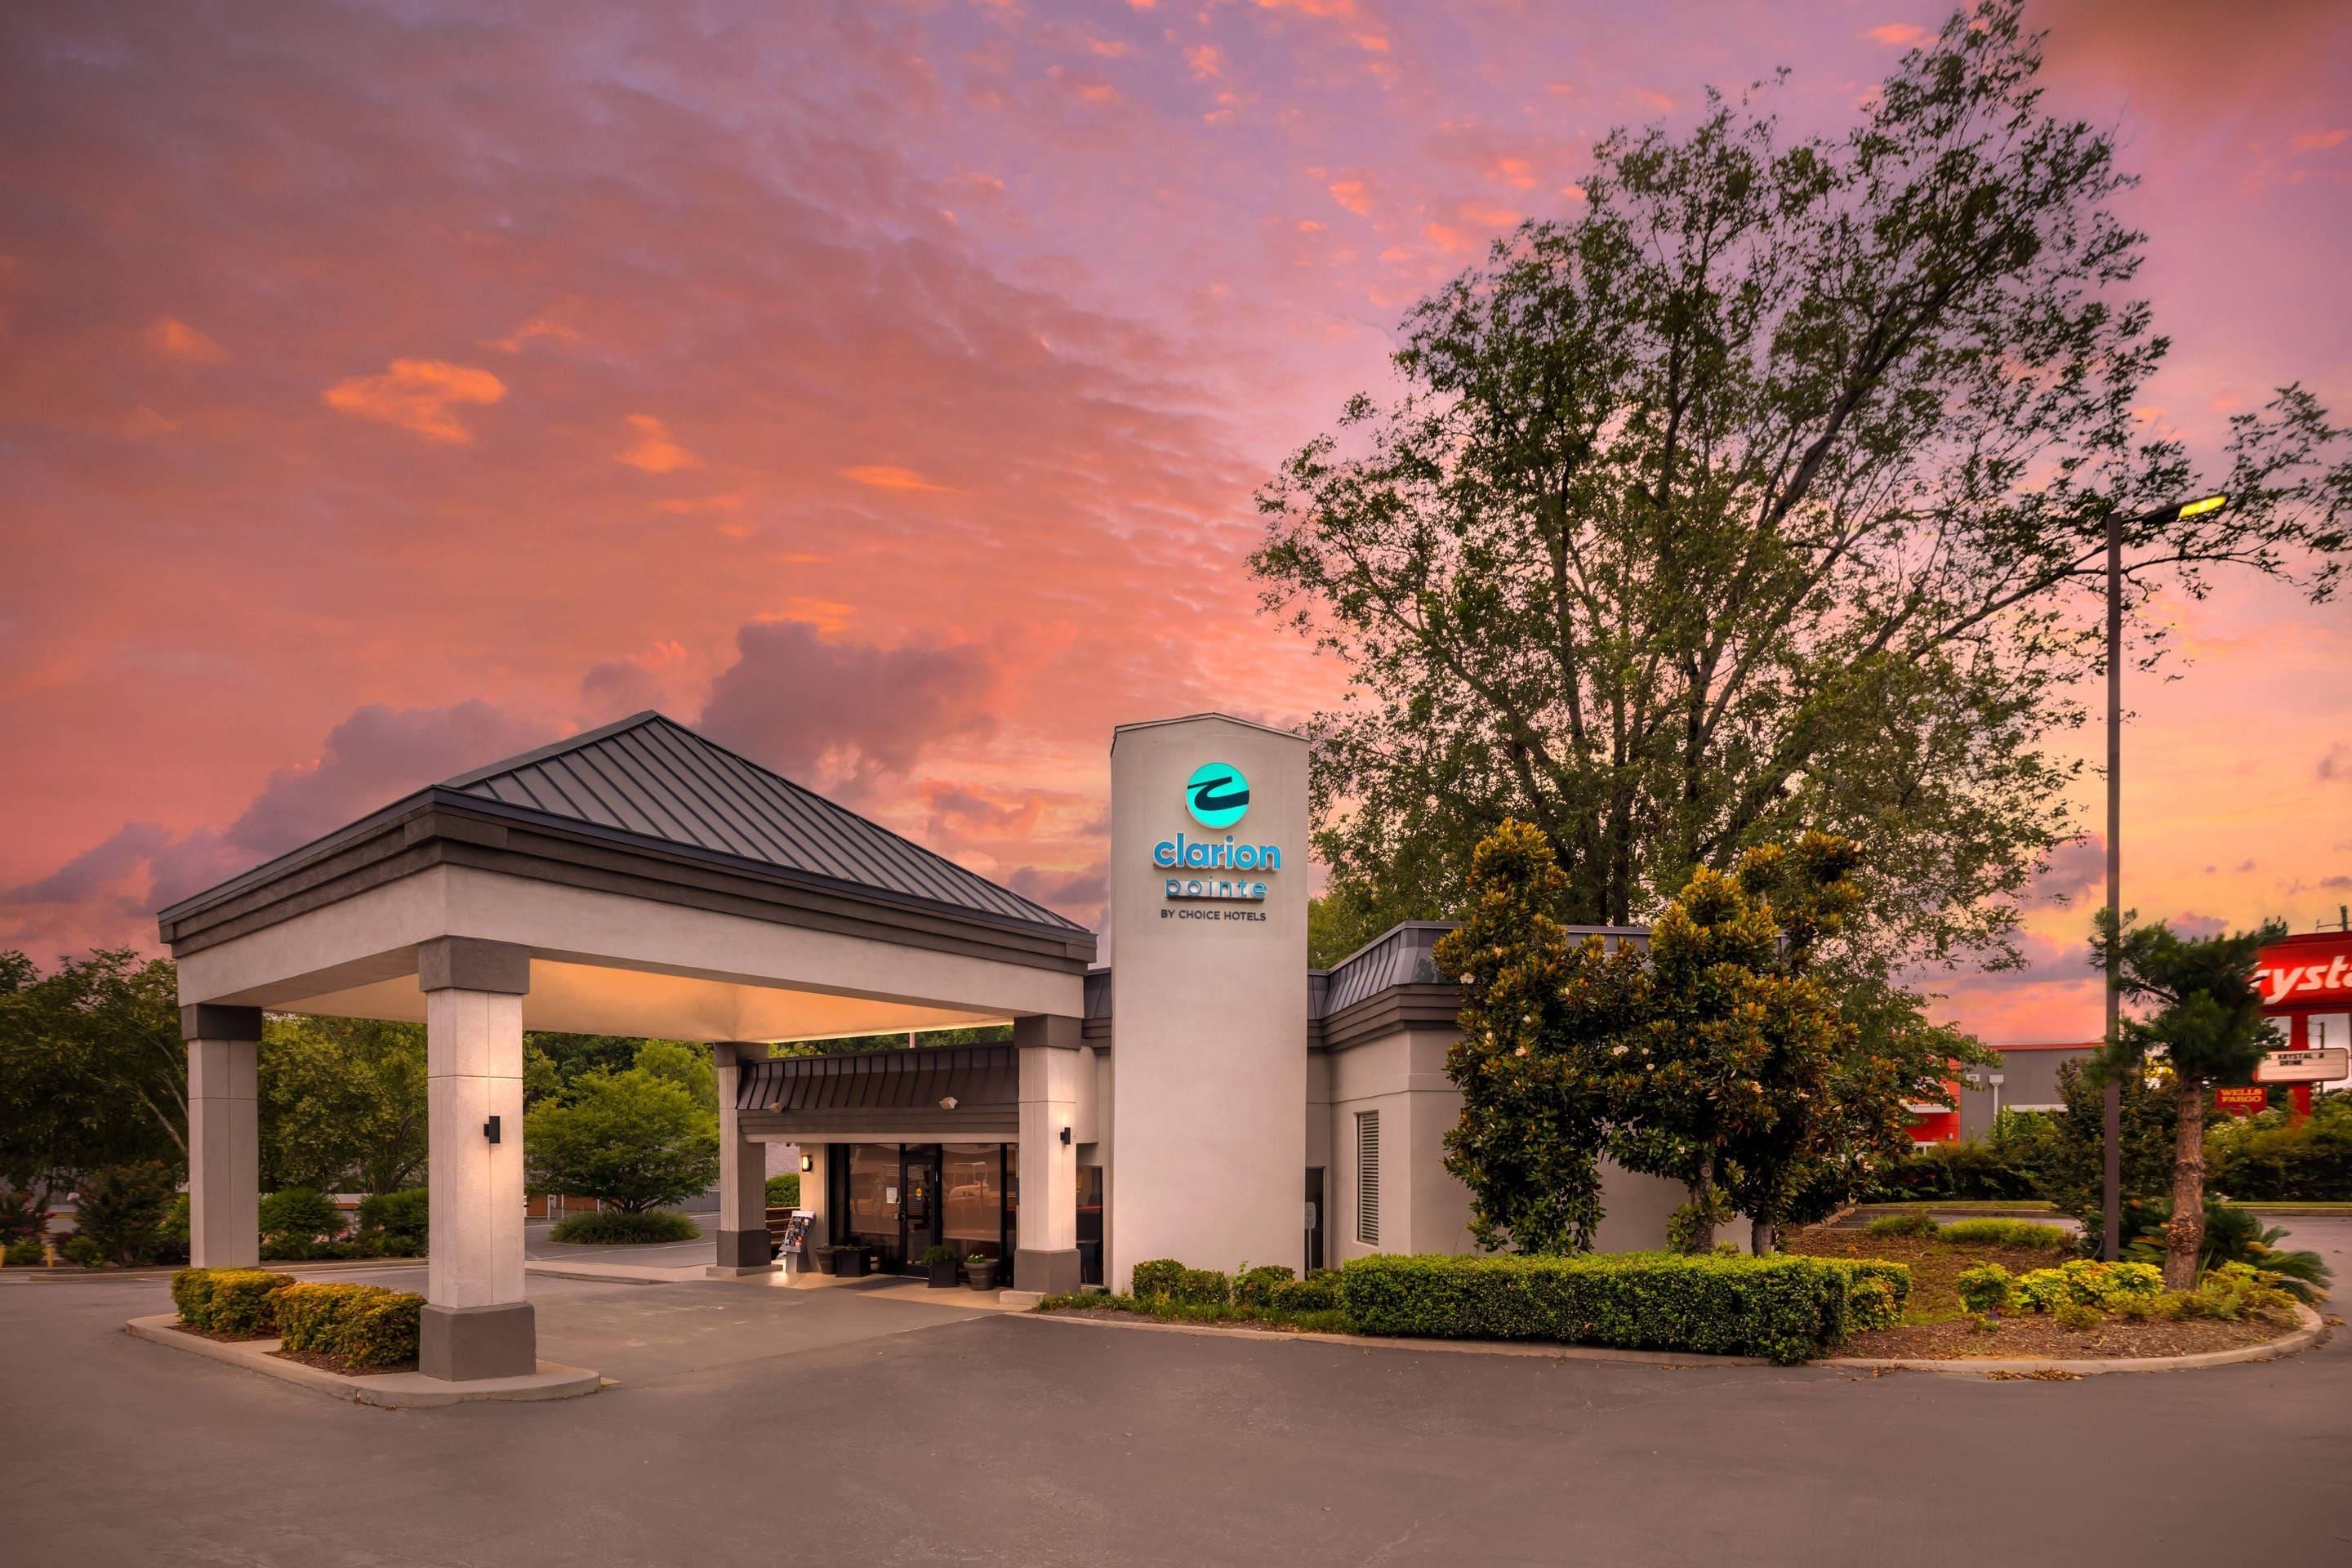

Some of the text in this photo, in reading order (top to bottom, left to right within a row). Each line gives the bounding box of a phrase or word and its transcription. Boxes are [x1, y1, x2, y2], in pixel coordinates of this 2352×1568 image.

[1153, 832, 1281, 870] clarion
[1165, 876, 1267, 899] pointe
[1160, 909, 1267, 922] BY CHOICE HOTELS
